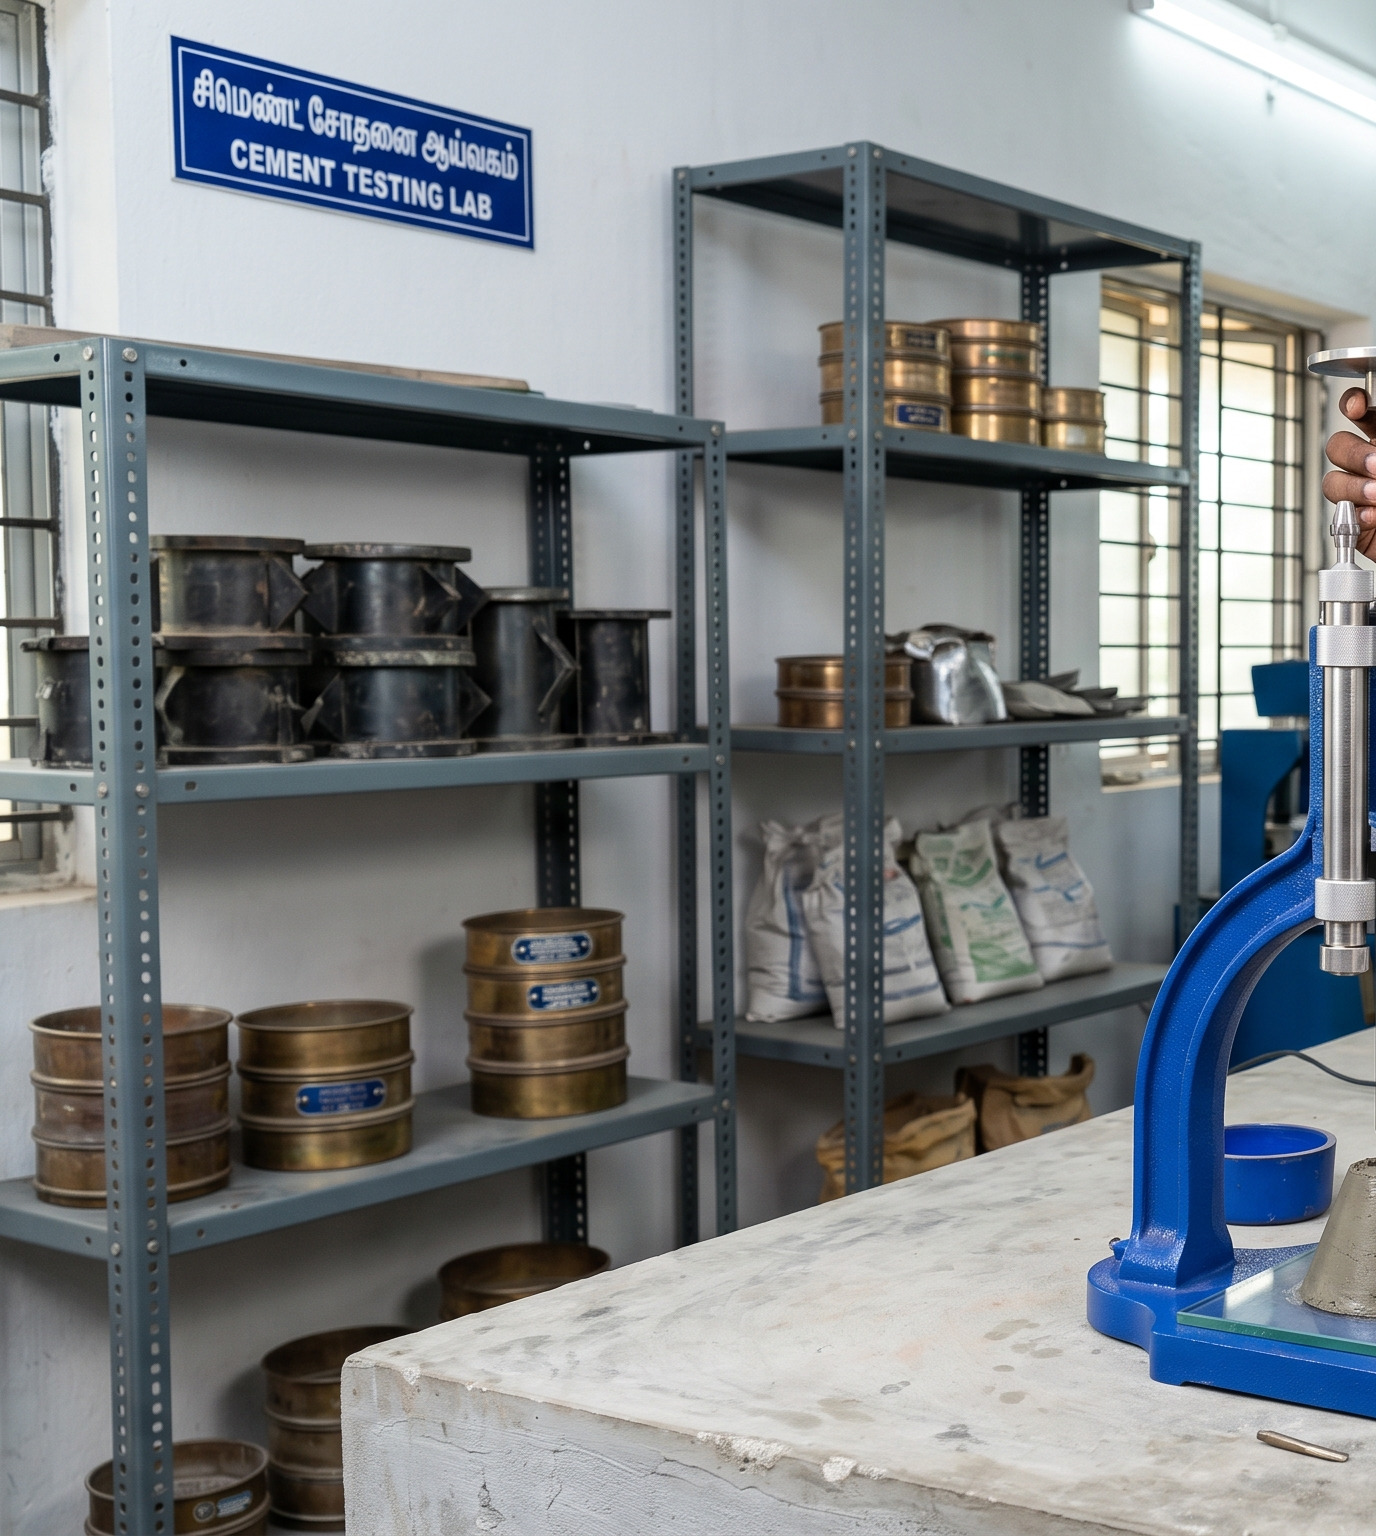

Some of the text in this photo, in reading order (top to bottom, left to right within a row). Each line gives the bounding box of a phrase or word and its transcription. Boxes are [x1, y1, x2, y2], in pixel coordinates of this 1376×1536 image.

[230, 138, 493, 221] CEMENT TESTING LAB
[307, 94, 418, 157] சோதனை
[421, 127, 519, 181] ஆய்வகம்
